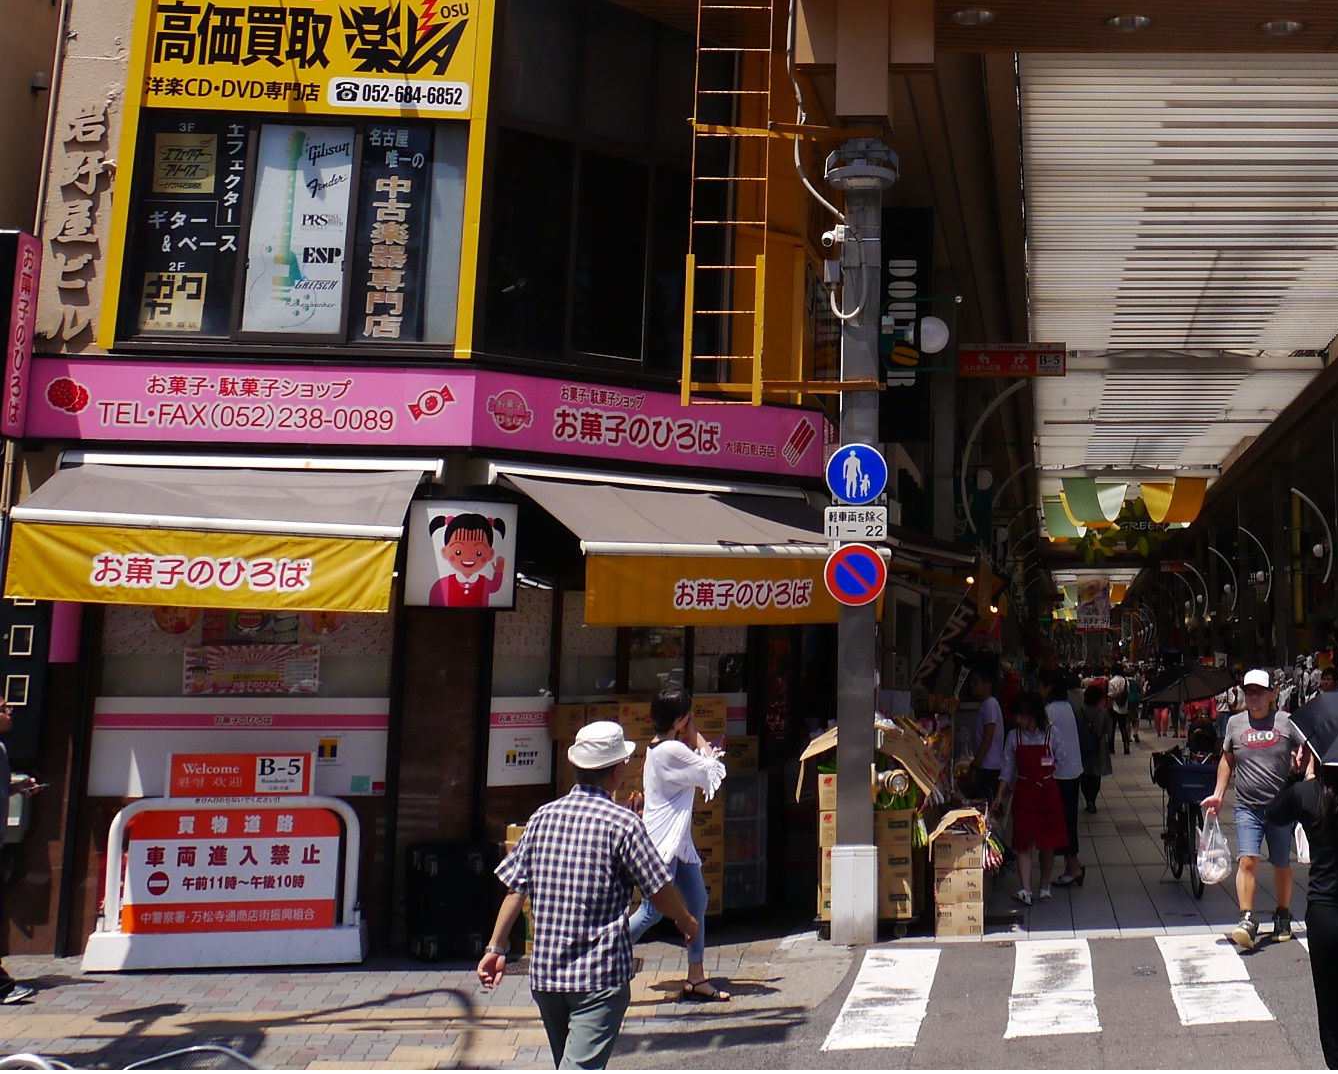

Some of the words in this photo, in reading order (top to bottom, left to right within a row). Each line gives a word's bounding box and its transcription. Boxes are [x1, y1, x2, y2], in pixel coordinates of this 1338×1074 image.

[441, 3, 469, 18] OSU
[153, 1, 332, 69] 高価買取
[362, 84, 463, 106] 052-684-6852
[179, 123, 195, 132] 3F
[370, 129, 409, 147] 名古屋
[309, 143, 350, 166] Gibson
[385, 151, 425, 169] 唯一の
[223, 124, 245, 223] エフェクター
[148, 210, 208, 230] ギター
[302, 214, 328, 226] PRS
[177, 235, 237, 252] ベース
[303, 247, 341, 264] ESP
[363, 176, 411, 338] 中古楽器専門店
[168, 262, 186, 271] 2F
[294, 280, 338, 290] GRETSCH
[1039, 355, 1060, 365] B-5
[554, 408, 720, 453] お菓子のひろば
[829, 512, 883, 523] 軽車両を除く
[1119, 521, 1165, 531] GREEN
[93, 556, 312, 590] お菓子のひろば
[675, 580, 812, 608] お菓子のひろば
[1248, 732, 1274, 741] HCO
[183, 763, 239, 774] Welcome
[258, 758, 300, 776] B-5
[178, 815, 294, 835] 買物道路
[145, 844, 321, 867] 車両進入禁止
